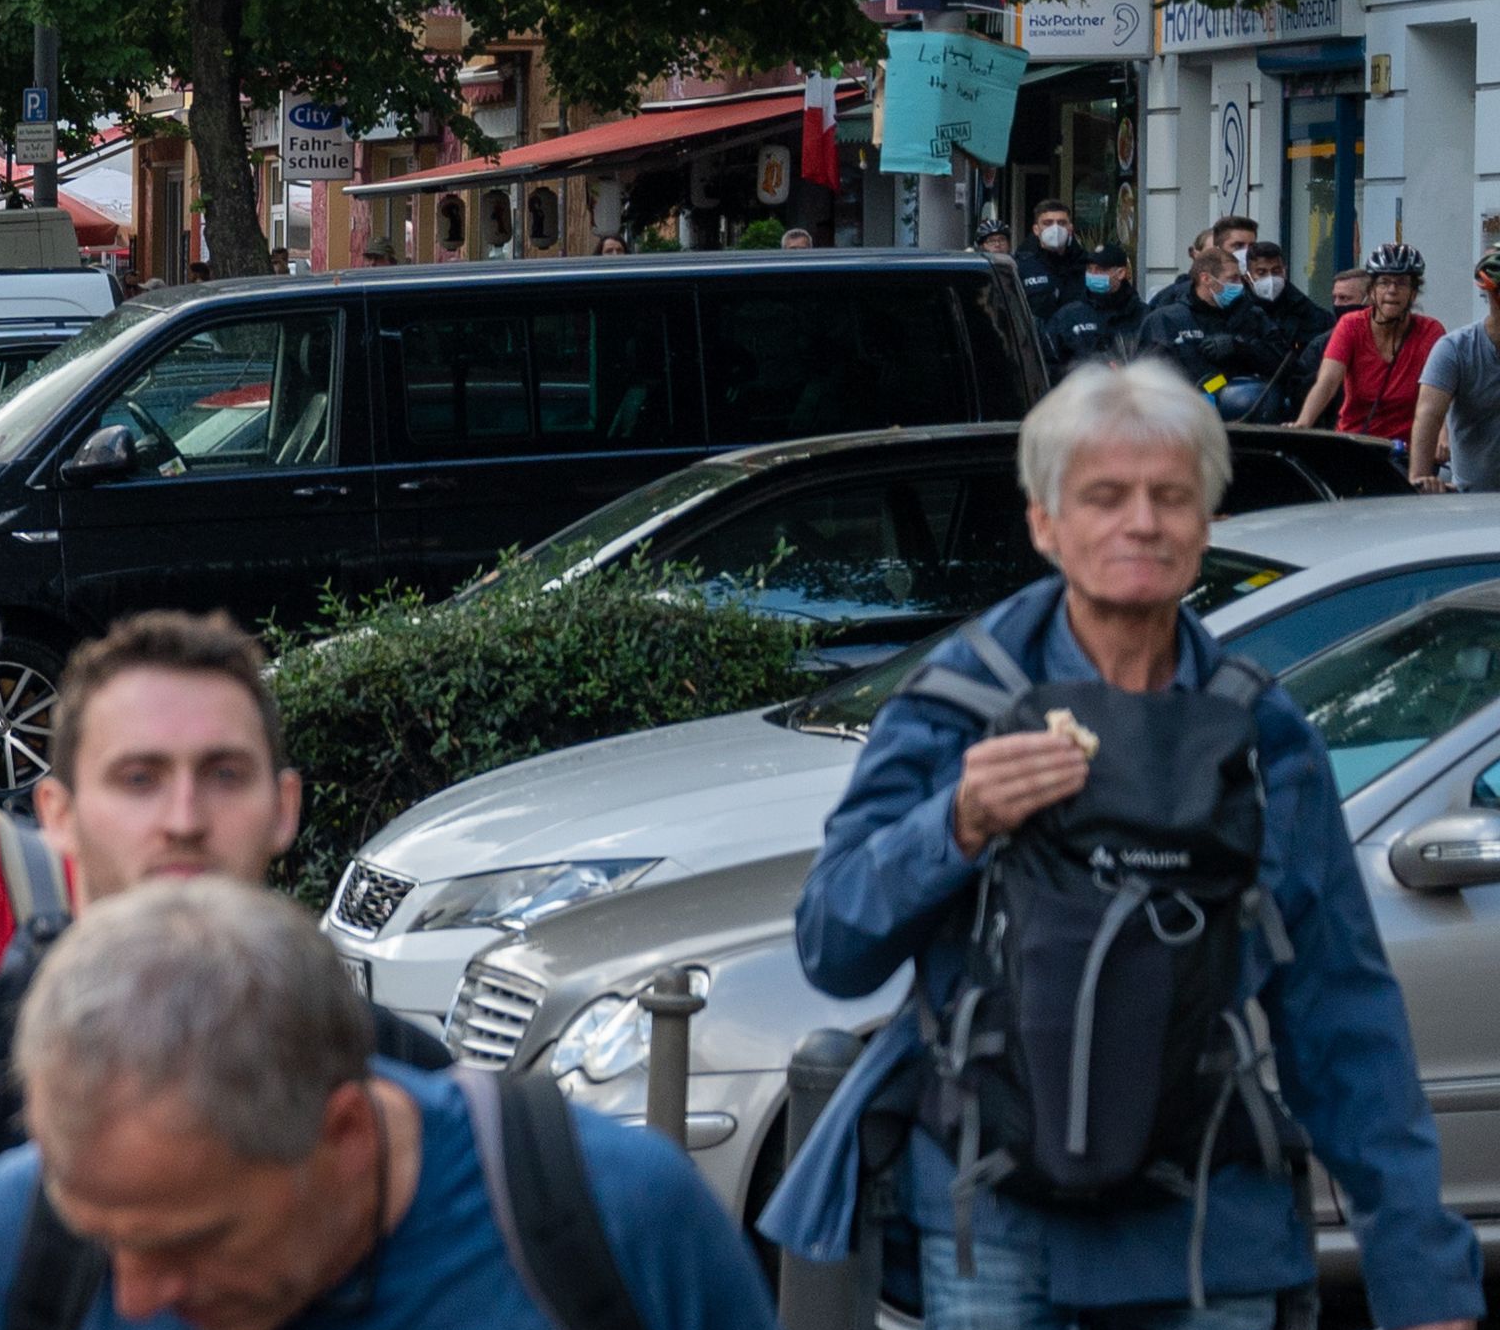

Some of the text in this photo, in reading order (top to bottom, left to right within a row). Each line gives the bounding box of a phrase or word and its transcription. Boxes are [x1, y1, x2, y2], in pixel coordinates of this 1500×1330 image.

[1029, 14, 1106, 28] HörPartner
[1029, 27, 1086, 38] DEIN HÖRGERÄT
[929, 75, 948, 90] the
[27, 93, 40, 119] P
[294, 108, 331, 126] City
[939, 124, 968, 140] KLIMA
[289, 137, 342, 151] Fahr-
[288, 155, 349, 169] schule
